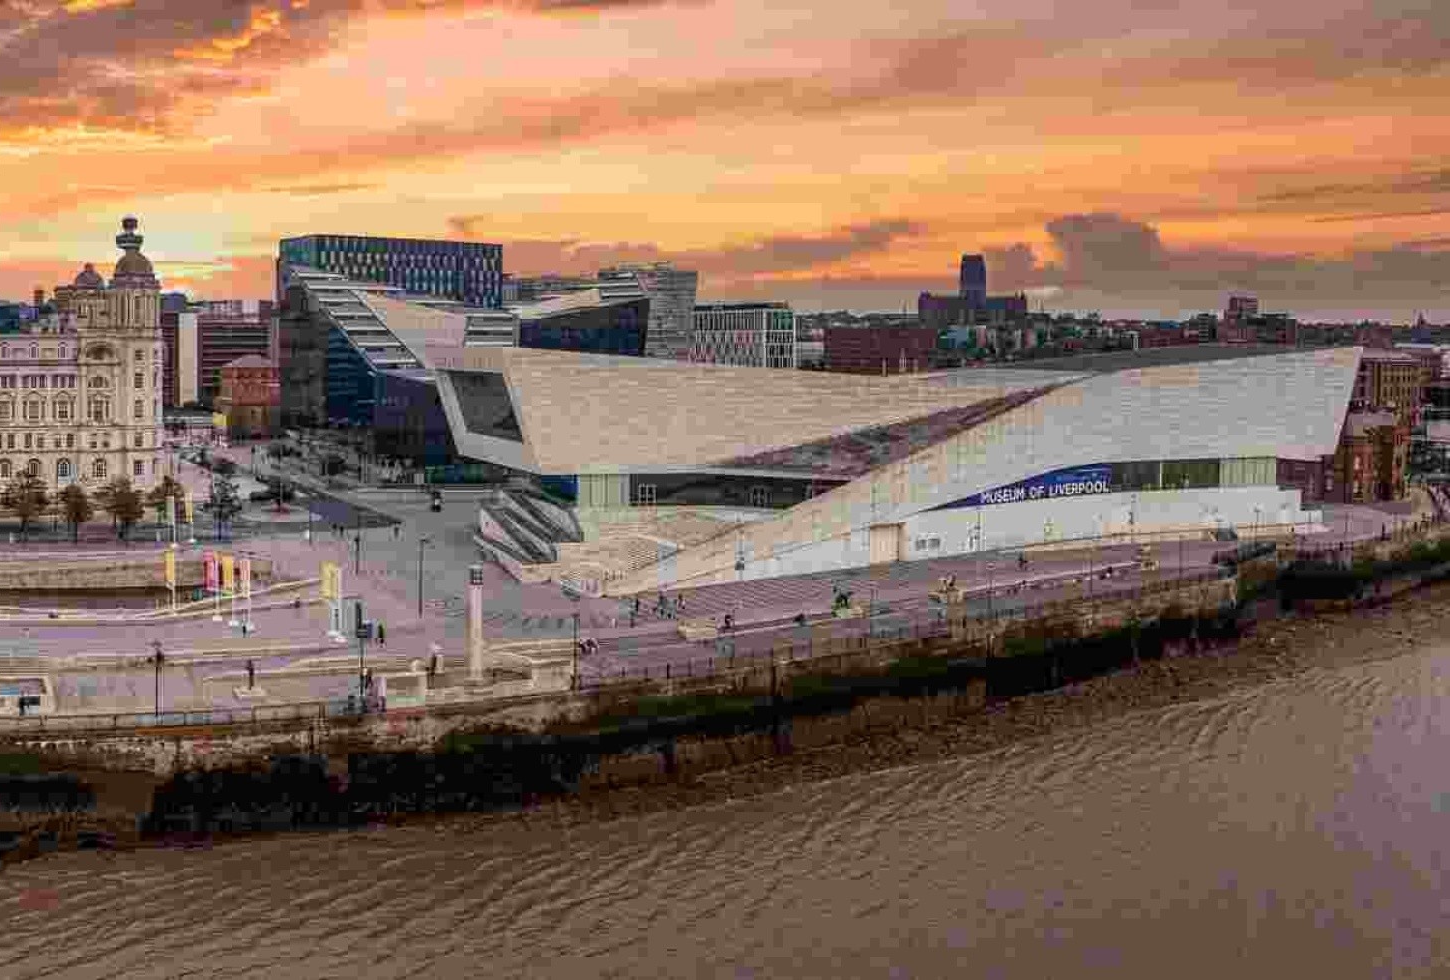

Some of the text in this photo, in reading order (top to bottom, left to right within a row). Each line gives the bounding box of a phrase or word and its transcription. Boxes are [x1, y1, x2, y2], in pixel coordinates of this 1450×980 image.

[980, 481, 1109, 503] MUSEUM OF LIVERPOOL
